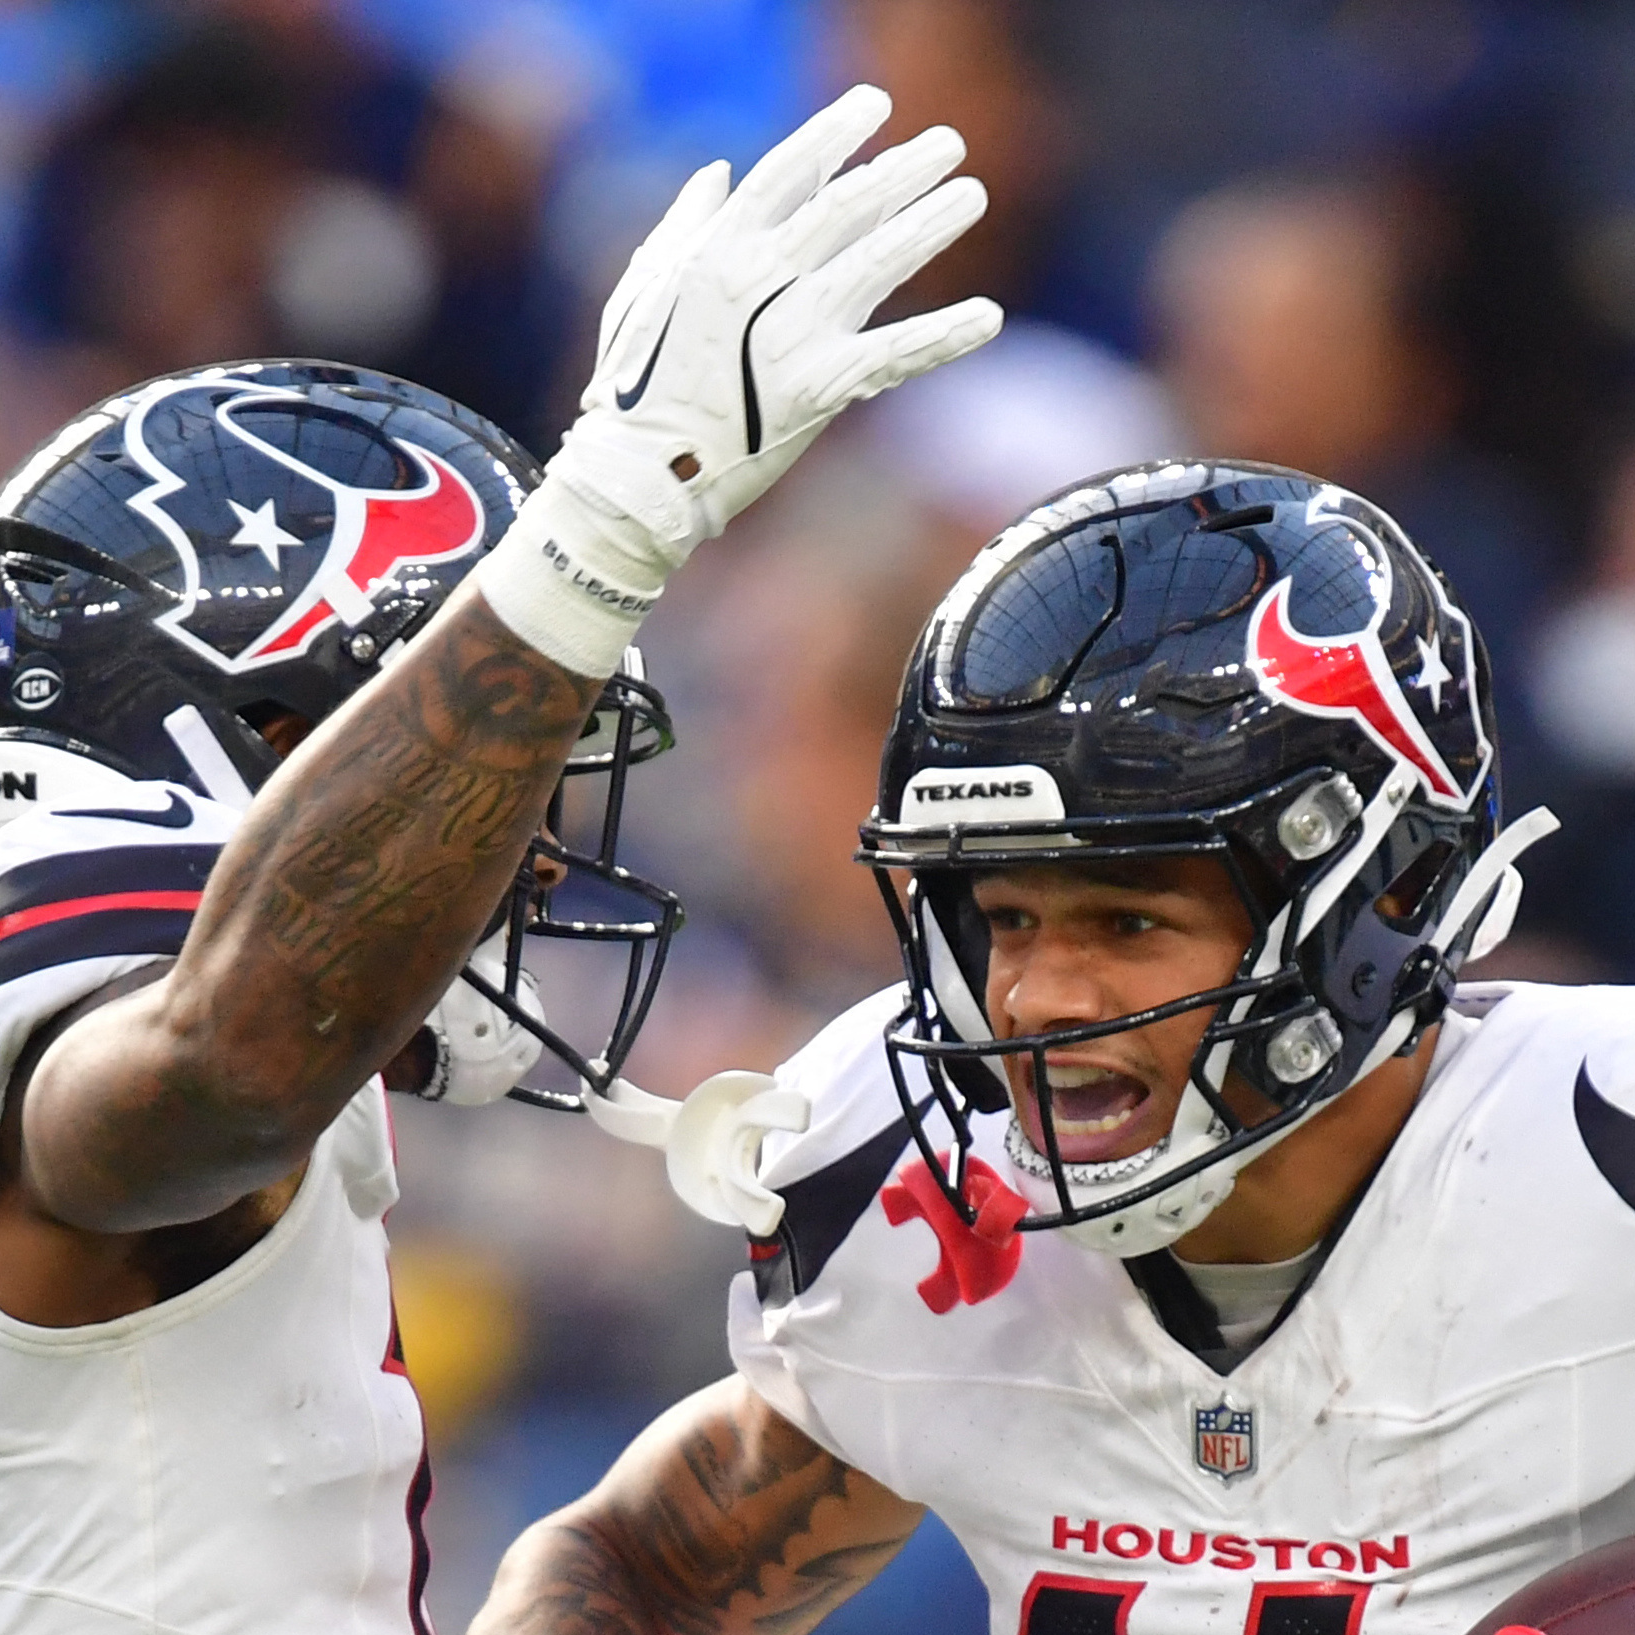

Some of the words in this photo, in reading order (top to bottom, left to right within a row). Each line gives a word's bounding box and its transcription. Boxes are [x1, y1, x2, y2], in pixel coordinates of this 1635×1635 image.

[912, 780, 1034, 804] TEXANS
[1202, 1434, 1247, 1470] NFL
[1052, 1515, 1410, 1574] HOUSTON
